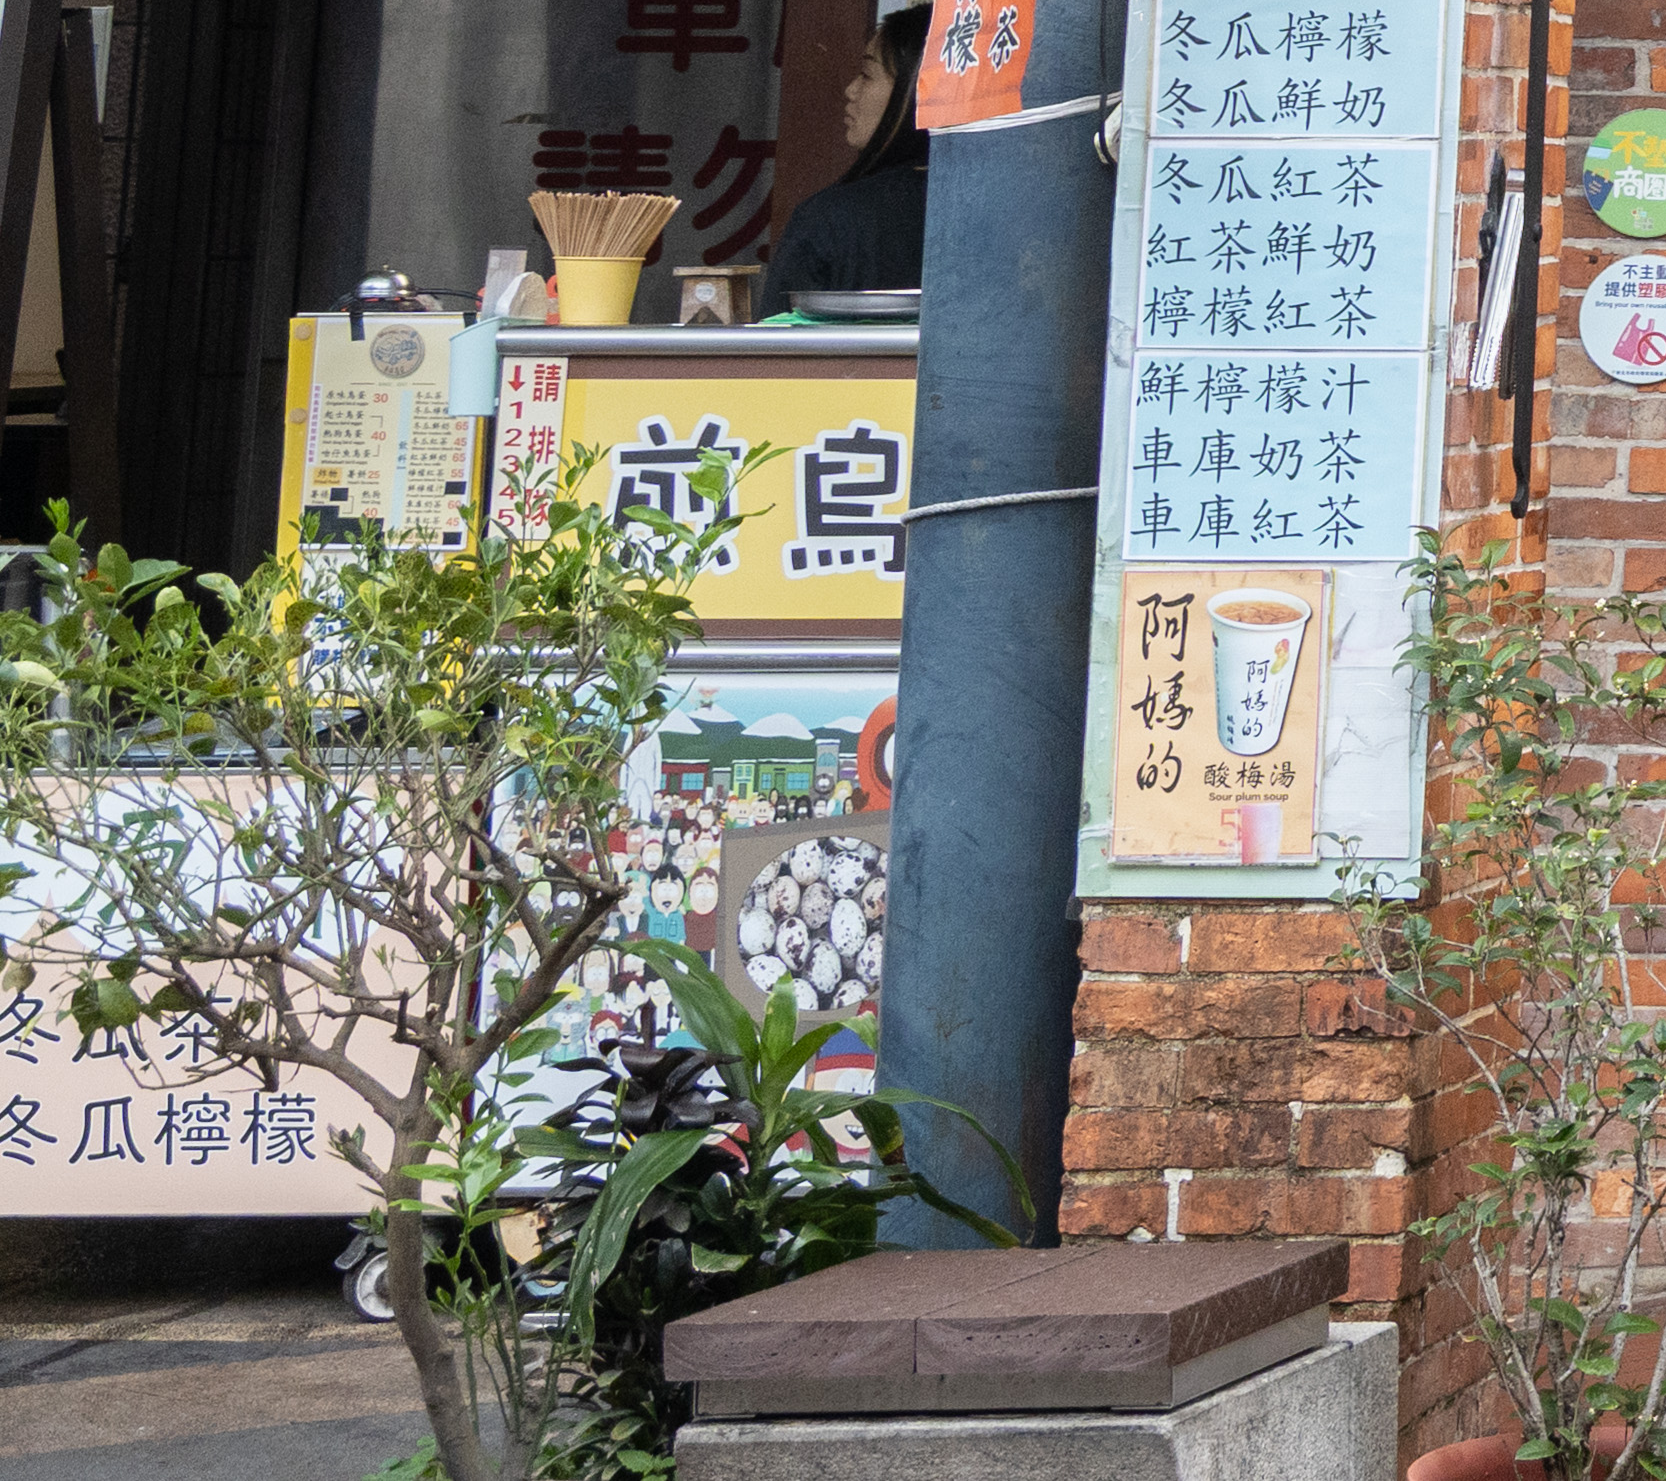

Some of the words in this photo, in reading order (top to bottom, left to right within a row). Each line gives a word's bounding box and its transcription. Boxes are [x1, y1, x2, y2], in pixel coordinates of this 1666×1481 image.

[1161, 8, 1392, 64] 冬瓜檸檬
[1156, 75, 1387, 131] 冬瓜鮮奶
[1152, 150, 1384, 208] 冬瓜紅茶
[1145, 219, 1377, 276] 紅茶鮮奶
[1142, 284, 1377, 340] 檸檬紅茶
[1594, 300, 1617, 311] Bring
[1617, 302, 1630, 311] your
[1630, 302, 1646, 310] own
[1135, 360, 1372, 417] 鮮檸檬汁
[1132, 426, 1366, 485] 車庫奶茶
[1130, 492, 1364, 550] 車庫紅茶
[1131, 592, 1196, 795] 阿媽的
[1240, 659, 1271, 739] 阿媽的
[1203, 760, 1297, 790] 酸梅湯
[1208, 791, 1233, 802] Sour
[1234, 791, 1262, 804] plum
[1262, 792, 1290, 804] soup
